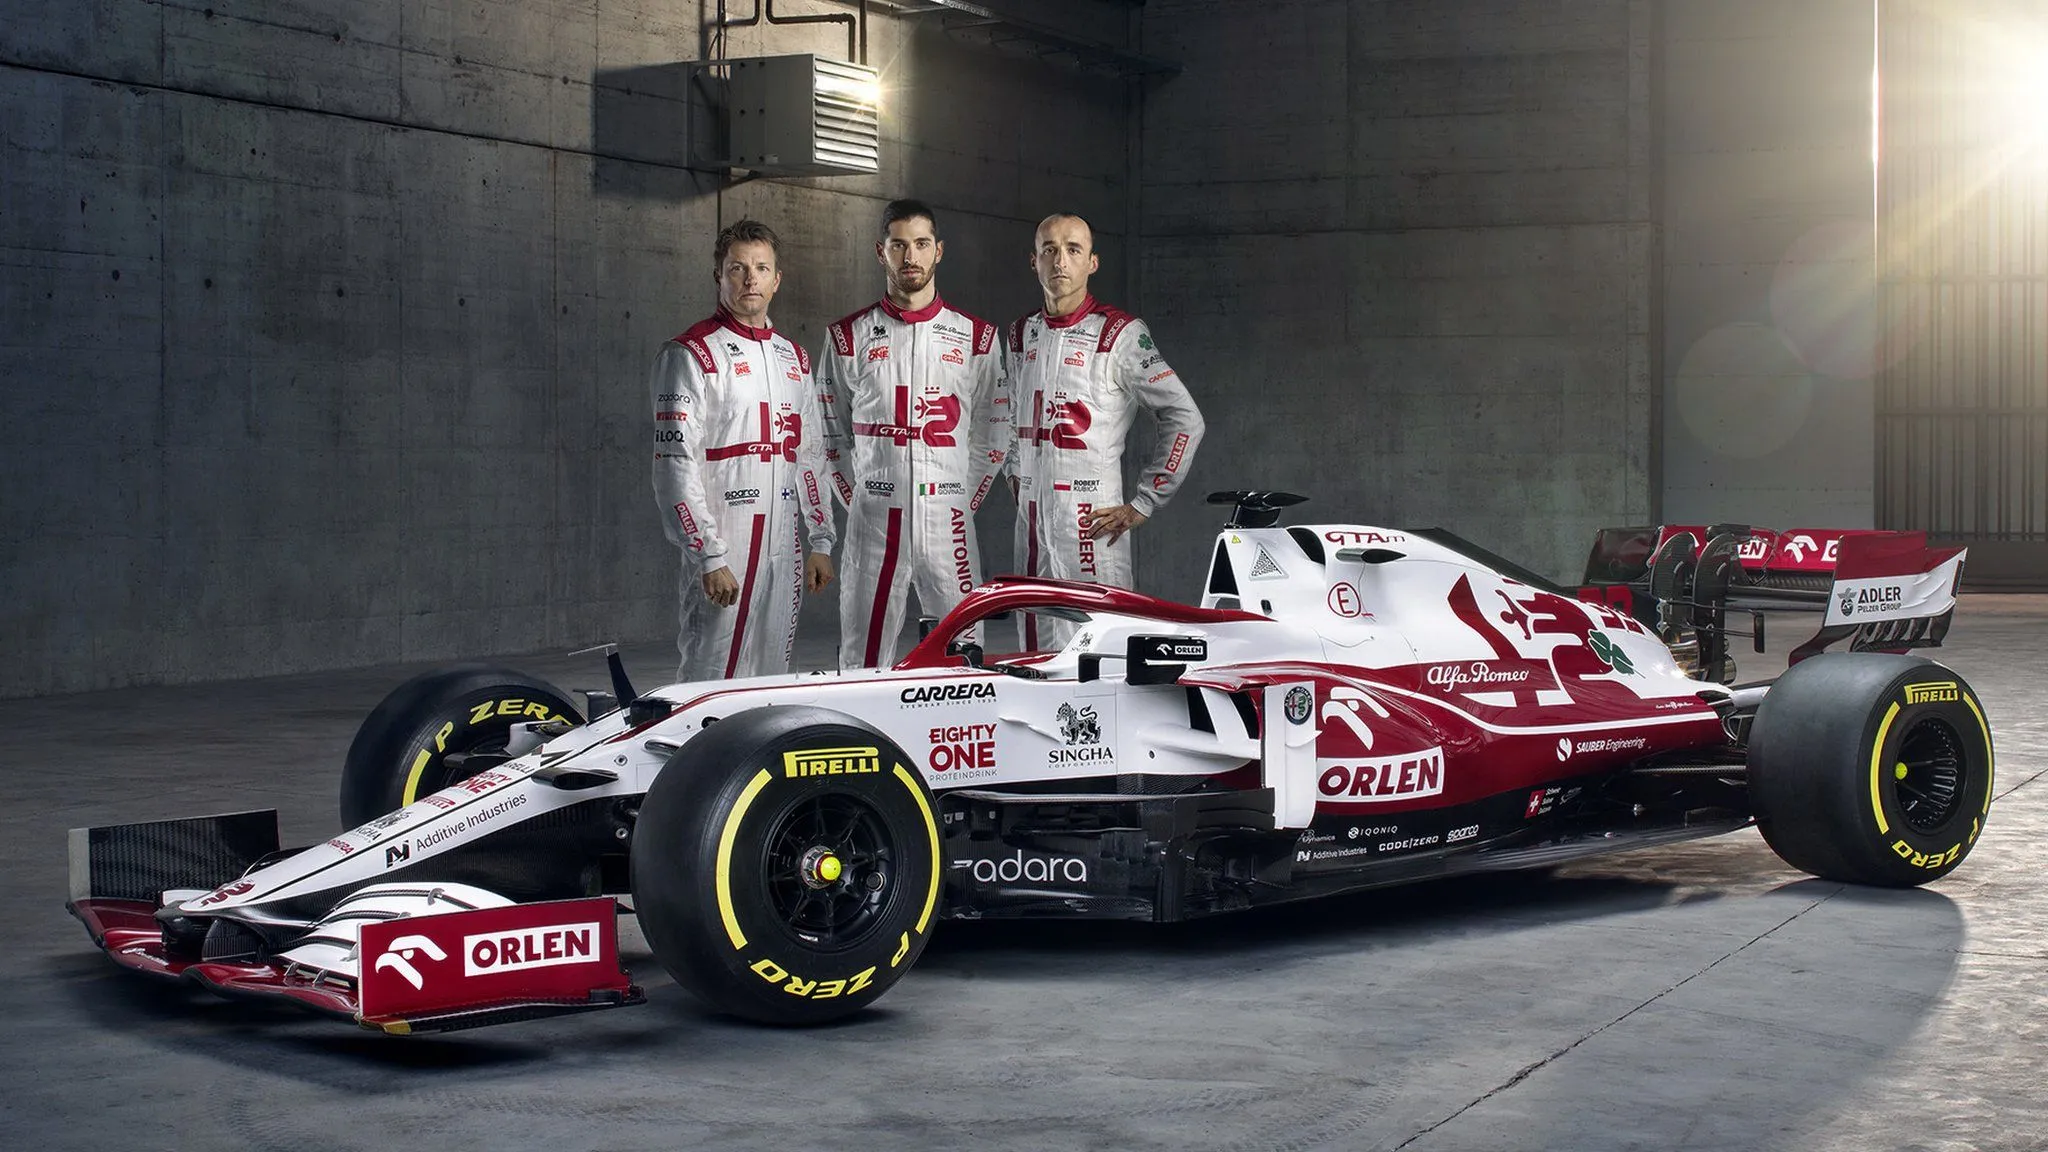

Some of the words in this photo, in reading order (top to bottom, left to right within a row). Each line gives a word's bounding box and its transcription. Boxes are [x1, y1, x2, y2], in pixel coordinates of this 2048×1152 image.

[655, 430, 685, 442] iLOQ
[1168, 435, 1187, 469] ORLEN
[725, 489, 760, 500] sparco
[805, 473, 819, 504] ORLEN
[834, 475, 852, 503] ORLE
[676, 506, 697, 534] ORLEN
[951, 507, 973, 594] ANTONIO
[1077, 503, 1096, 576] ROBERT
[1337, 587, 1355, 614] E
[1858, 586, 1901, 603] ADLER
[1176, 646, 1202, 654] ORLEN
[1427, 665, 1472, 692] Alfa
[1471, 662, 1529, 682] Romeo
[900, 682, 996, 703] CARRERA
[1904, 681, 1959, 705] PIRELLI
[434, 721, 454, 753] P
[929, 723, 997, 744] EIGHTY
[1575, 739, 1605, 754] SAUBER
[1605, 736, 1646, 752] Engineering
[783, 746, 879, 778] PIRELLI
[929, 742, 996, 772] ONE
[1049, 746, 1113, 763] SINGHA
[929, 769, 997, 782] PROTEINDRINK
[1318, 756, 1439, 796] ORLEN
[416, 820, 466, 851] Additive
[466, 792, 527, 829] Industries
[1360, 825, 1398, 837] IQONIQ
[1446, 824, 1479, 842] sparco
[1969, 817, 1979, 844] P
[1312, 850, 1338, 860] Additive
[1338, 847, 1367, 858] Industries
[1892, 839, 1961, 869] ZERO
[472, 929, 591, 968] ORLEN
[891, 931, 910, 968] P
[750, 958, 876, 999] ZERO
